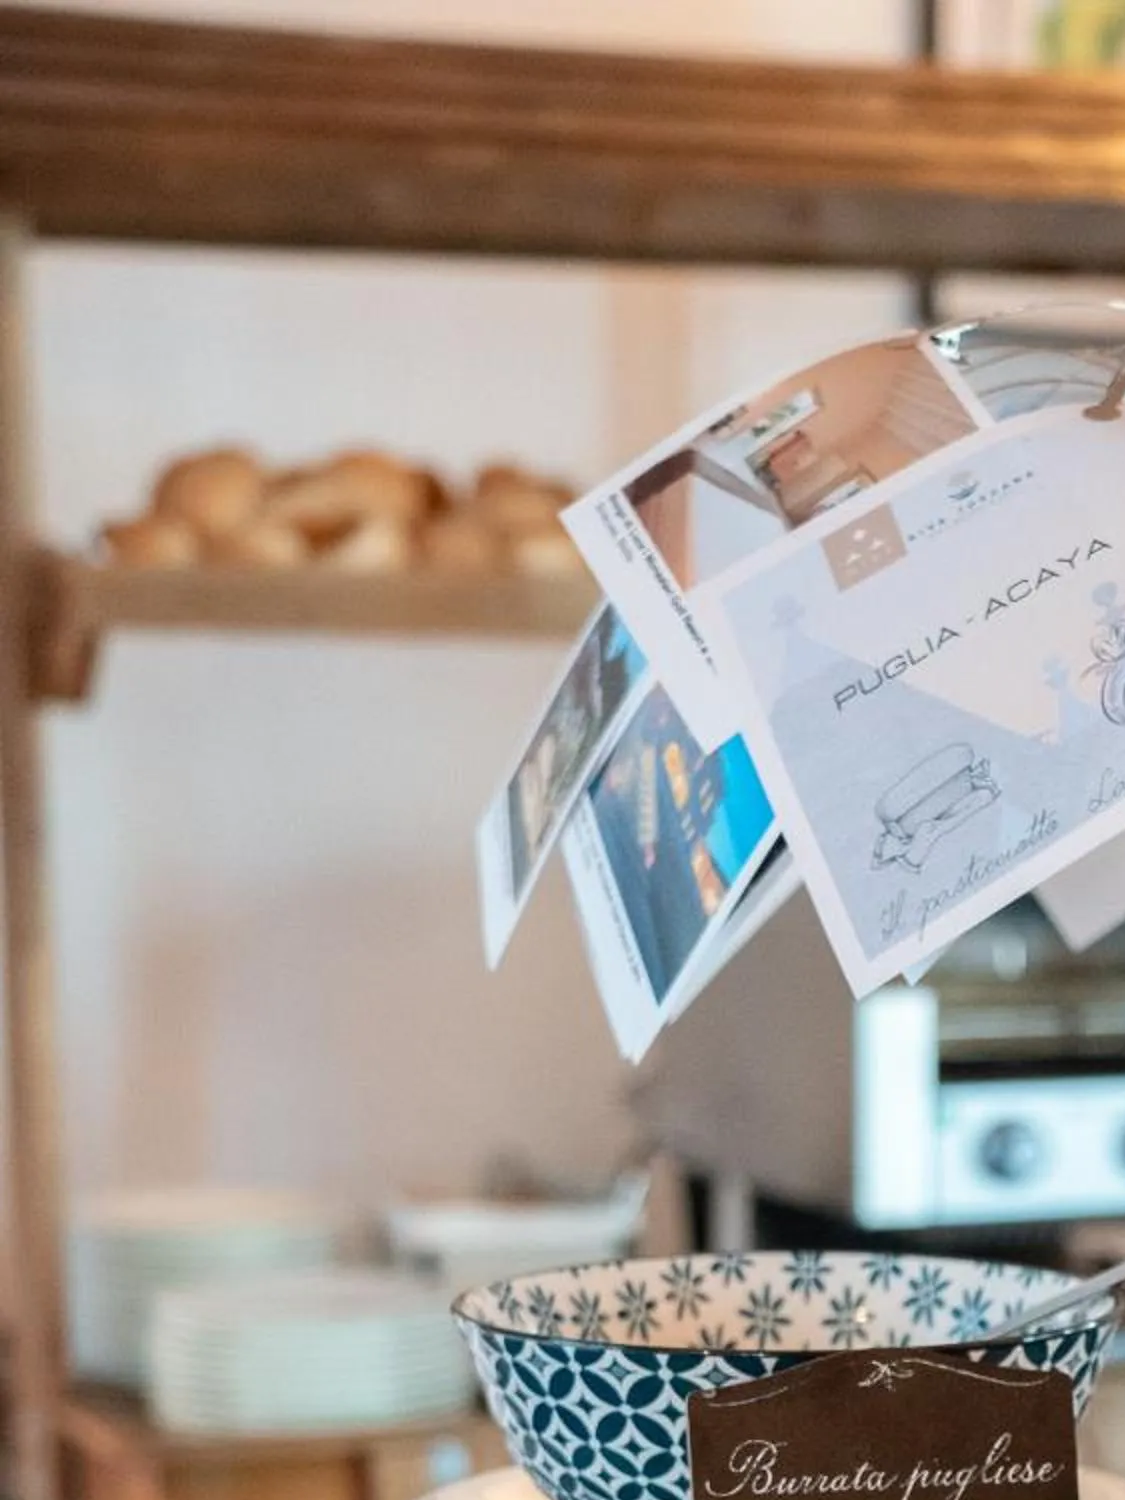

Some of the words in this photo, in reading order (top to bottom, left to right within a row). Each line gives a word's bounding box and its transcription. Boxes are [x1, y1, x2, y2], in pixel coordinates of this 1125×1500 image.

[832, 626, 961, 713] PUGLIA
[984, 538, 1114, 621] ACAYA
[705, 1438, 897, 1498] Burrata
